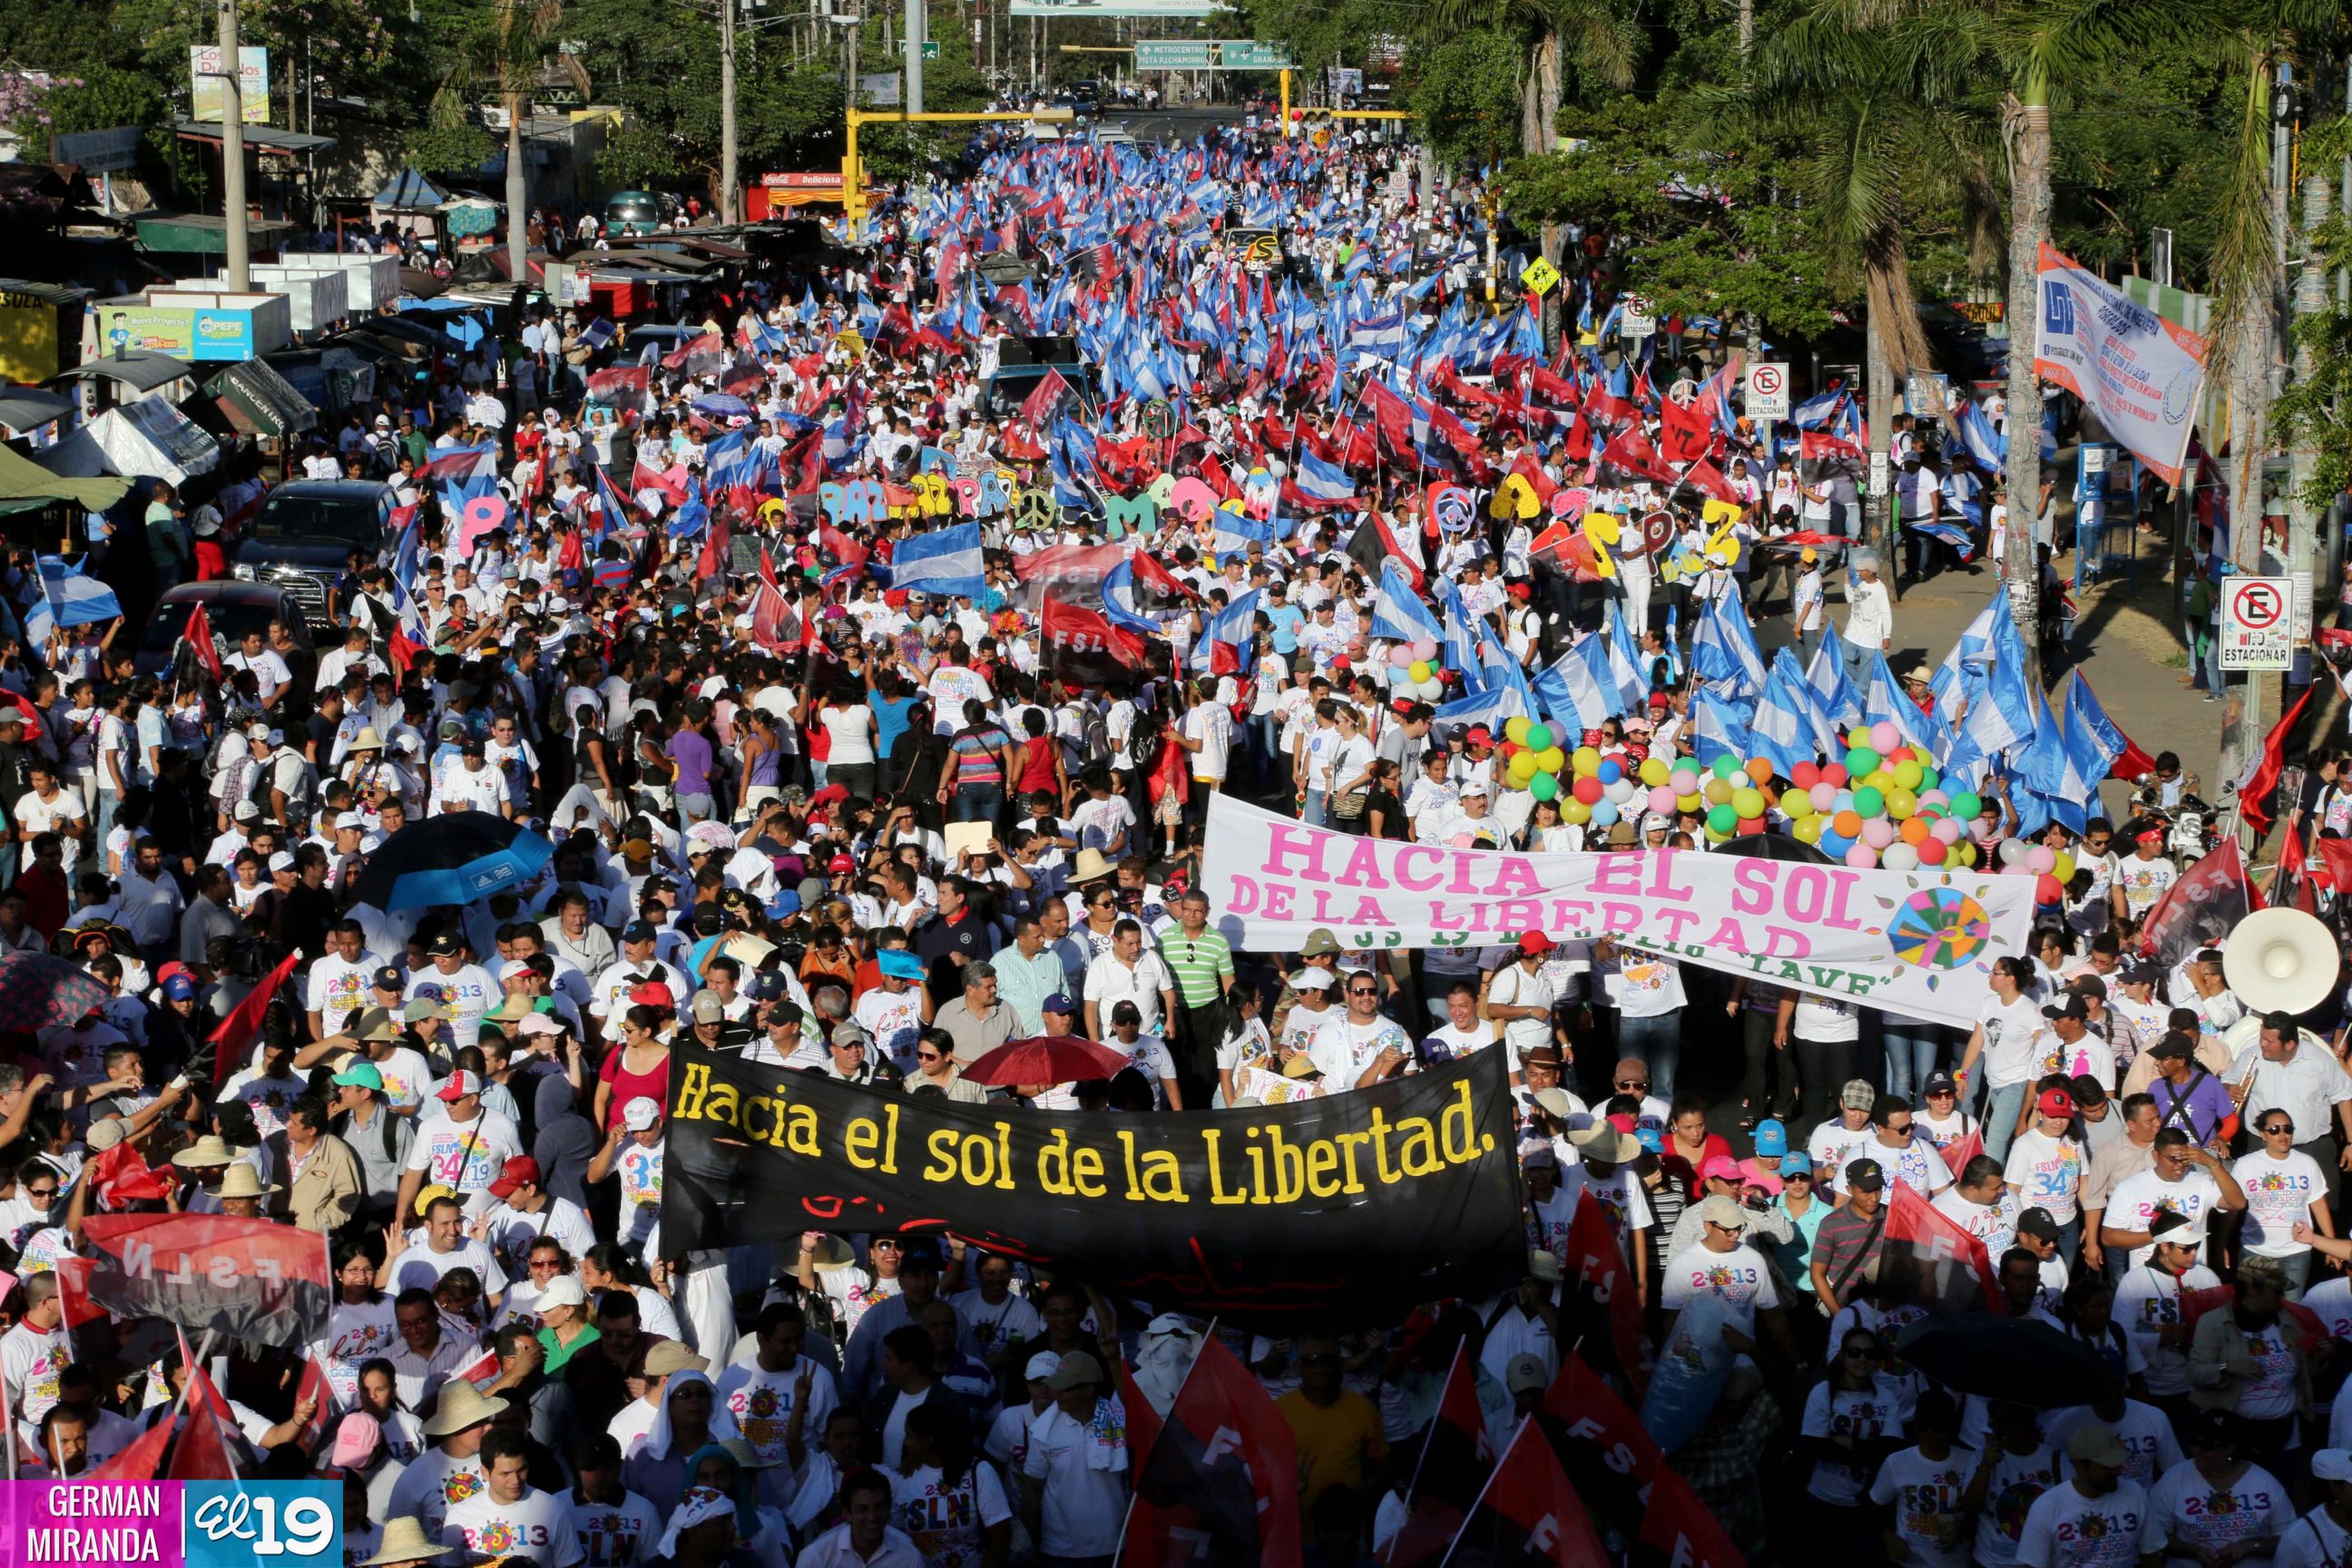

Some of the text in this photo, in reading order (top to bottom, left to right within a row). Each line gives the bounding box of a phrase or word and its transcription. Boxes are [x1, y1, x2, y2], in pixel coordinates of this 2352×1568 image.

[1154, 45, 1204, 54] METROCENTRO
[802, 175, 841, 184] Deliciosa
[213, 321, 243, 331] PEPE
[1749, 407, 1786, 416] ESTACIONAR
[819, 478, 887, 526] PAZ
[955, 466, 1021, 519] PAZ
[458, 496, 506, 558] P
[2248, 591, 2269, 619] E
[2224, 648, 2287, 662] ESTACIONAR
[1260, 821, 1862, 931] HACIA EL SOL
[1227, 874, 1812, 959] DE LA LIBERTAD
[671, 1063, 1495, 1204] Hacia el sol de la Libertad.
[2032, 1168, 2067, 1196] 34
